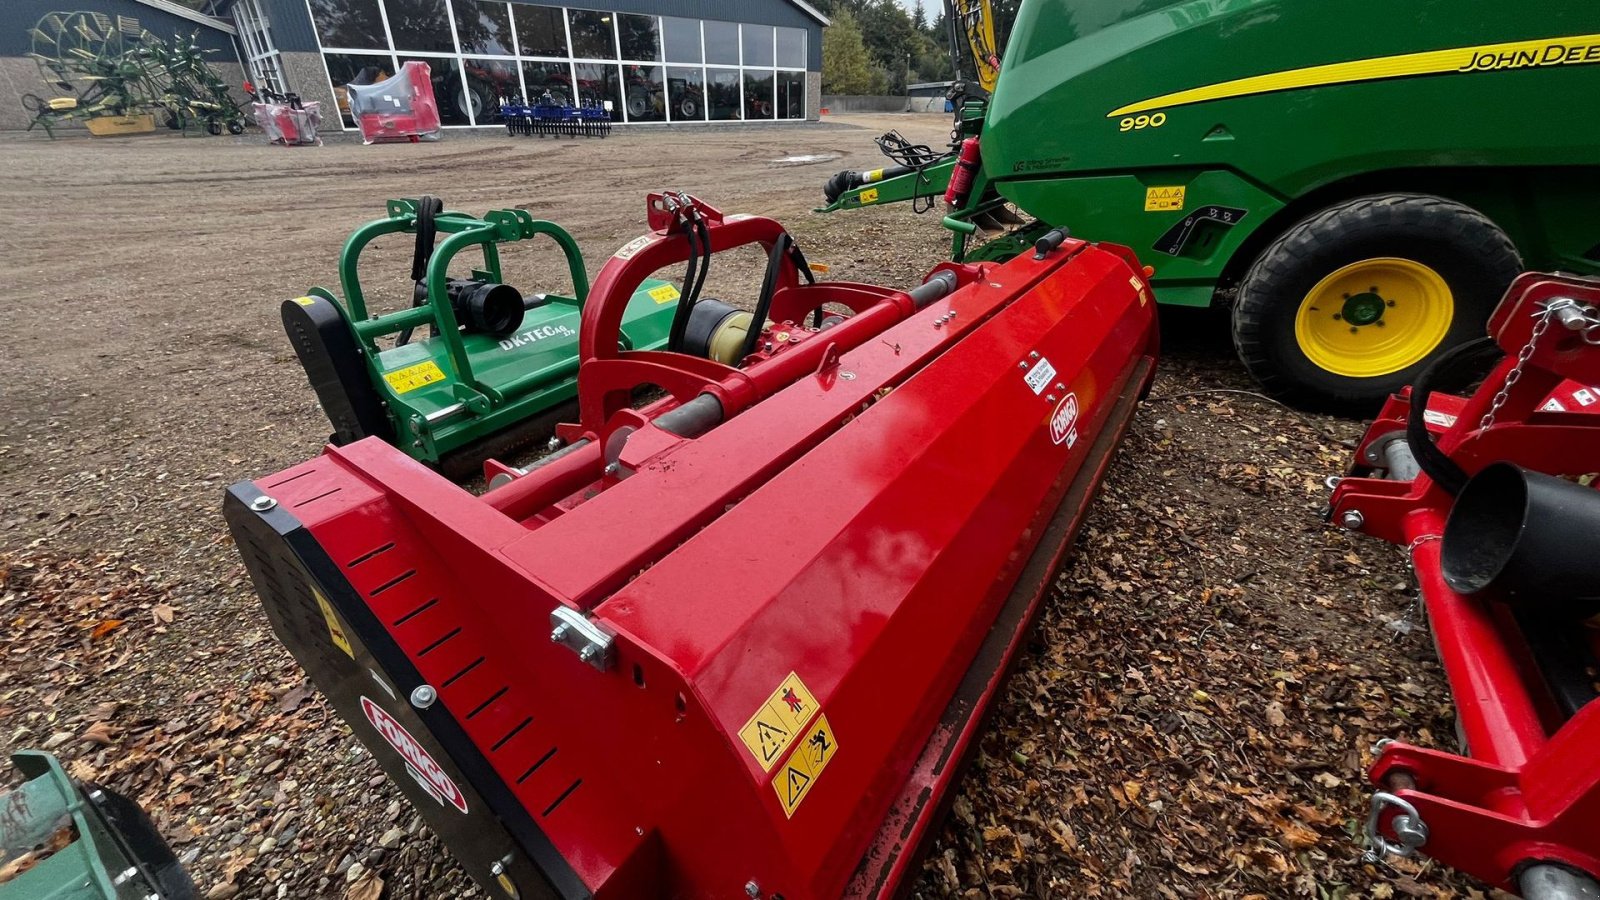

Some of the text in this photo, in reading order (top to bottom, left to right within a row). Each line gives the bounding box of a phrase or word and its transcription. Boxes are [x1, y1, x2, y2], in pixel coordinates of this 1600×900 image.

[1459, 50, 1538, 71] JOHN
[1120, 112, 1167, 132] 990
[499, 325, 555, 351] DK-TEC
[1052, 397, 1076, 440] FORIGO
[370, 704, 456, 800] FORIGO
